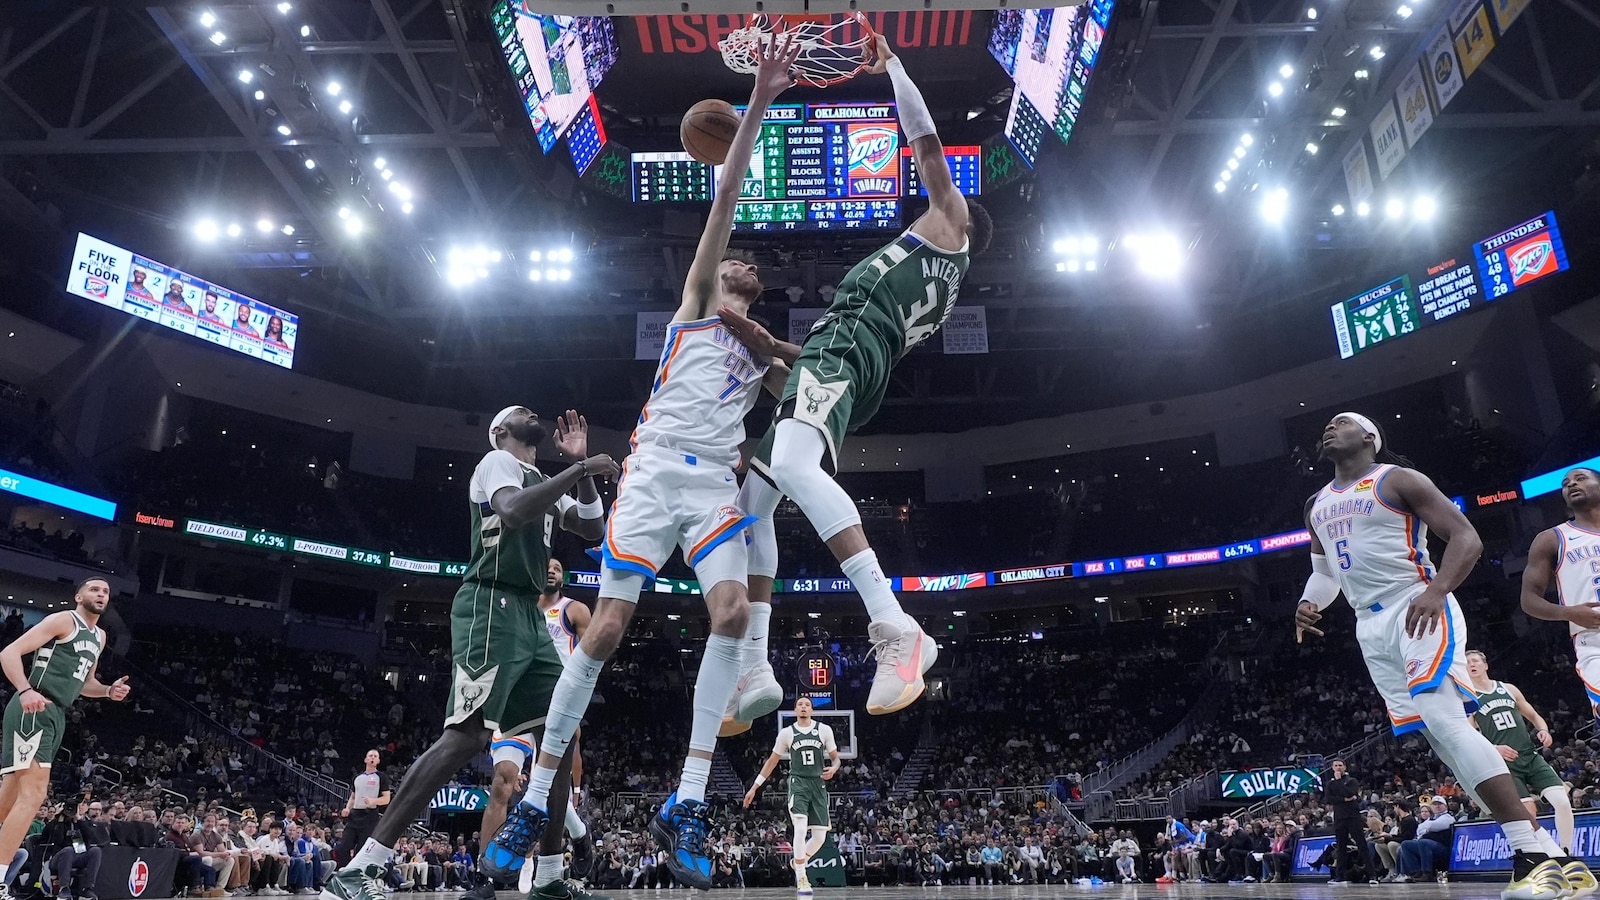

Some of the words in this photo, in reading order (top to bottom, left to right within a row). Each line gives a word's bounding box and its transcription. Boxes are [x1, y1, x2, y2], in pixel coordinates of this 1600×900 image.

[1463, 17, 1484, 54] 14
[1437, 54, 1452, 82] 24
[1405, 85, 1426, 123] 44
[815, 108, 867, 119] OKLAHOMA
[867, 107, 889, 118] CITY
[770, 127, 776, 135] 4
[768, 137, 779, 145] 29
[832, 136, 843, 144] 32
[1377, 120, 1399, 156] HANK
[768, 148, 779, 156] 26
[832, 146, 842, 154] 21
[848, 137, 889, 165] OKC
[834, 157, 843, 165] 10
[771, 178, 777, 186] 8
[834, 178, 844, 186] 16
[854, 178, 892, 194] THUNDER
[772, 189, 776, 197] 1
[748, 204, 773, 212] 14-37
[782, 204, 798, 212] 6-9
[810, 202, 836, 210] 43-78
[841, 202, 866, 210] 13-32
[871, 201, 896, 209] 10-15
[1484, 219, 1545, 250] THUNDER
[88, 249, 116, 268] FIVE
[1484, 252, 1500, 265] 10
[1516, 247, 1542, 274] OKC
[78, 262, 120, 284] FLOOR
[1488, 264, 1503, 276] 48
[153, 277, 161, 287] 2
[1418, 280, 1434, 294] FAST
[1434, 270, 1458, 287] BREAK
[1457, 265, 1471, 278] PTS
[1494, 275, 1501, 285] 9
[188, 290, 196, 300] 5
[1358, 284, 1392, 306] BUCKS
[1420, 292, 1434, 304] PTS
[1433, 288, 1442, 298] IN
[1441, 282, 1456, 295] THE
[1454, 274, 1474, 290] PAINT
[1492, 284, 1508, 297] 28
[126, 294, 138, 302] FREE
[1394, 291, 1408, 304] 14
[1423, 301, 1438, 314] 2ND
[1437, 290, 1464, 308] CHANCE
[1464, 285, 1478, 297] PTS
[222, 302, 230, 311] 7
[1396, 302, 1410, 314] 34
[1434, 304, 1457, 320] BENCH
[1456, 298, 1470, 311] PTS
[253, 314, 264, 325] 11
[950, 312, 977, 321] DIVISION
[1336, 308, 1346, 332] HUSTLE
[1400, 312, 1408, 322] 5
[199, 320, 210, 328] FREE
[646, 322, 658, 330] NBA
[946, 320, 983, 330] CHAMPIONS
[1401, 321, 1414, 334] 43
[232, 332, 243, 340] FREE
[282, 326, 296, 337] 22
[1340, 331, 1350, 354] BOARD
[724, 352, 754, 382] CITY
[716, 372, 743, 403] 7
[1476, 491, 1518, 506] fiserv.forum
[136, 512, 174, 528] fiserv.forum
[190, 523, 214, 533] FIELD
[216, 528, 244, 538] GOALS
[544, 514, 554, 548] 9
[1326, 517, 1352, 540] CITY
[252, 534, 284, 548] 49.3%
[296, 542, 344, 556] 3-POINTERS
[1225, 544, 1254, 557] 66.7%
[1335, 537, 1353, 572] 5
[352, 551, 382, 564] 37.8%
[1126, 558, 1144, 568] TOL
[1150, 558, 1156, 566] 4
[1168, 553, 1186, 564] FREE
[1187, 551, 1218, 562] THROWS
[392, 558, 408, 568] FREE
[408, 560, 438, 571] THROWS
[446, 565, 467, 574] 66.7
[1087, 564, 1103, 573] FLS
[1109, 562, 1114, 570] 1
[1001, 568, 1045, 582] OKLAHOMA
[1046, 566, 1065, 578] CITY
[792, 578, 820, 592] 6:31
[831, 580, 850, 590] 4TH
[809, 659, 829, 670] 6:31
[812, 669, 827, 686] 18
[1492, 710, 1517, 731] 20
[802, 750, 814, 765] 13
[1239, 771, 1301, 798] BUCKS
[1462, 835, 1492, 865] League
